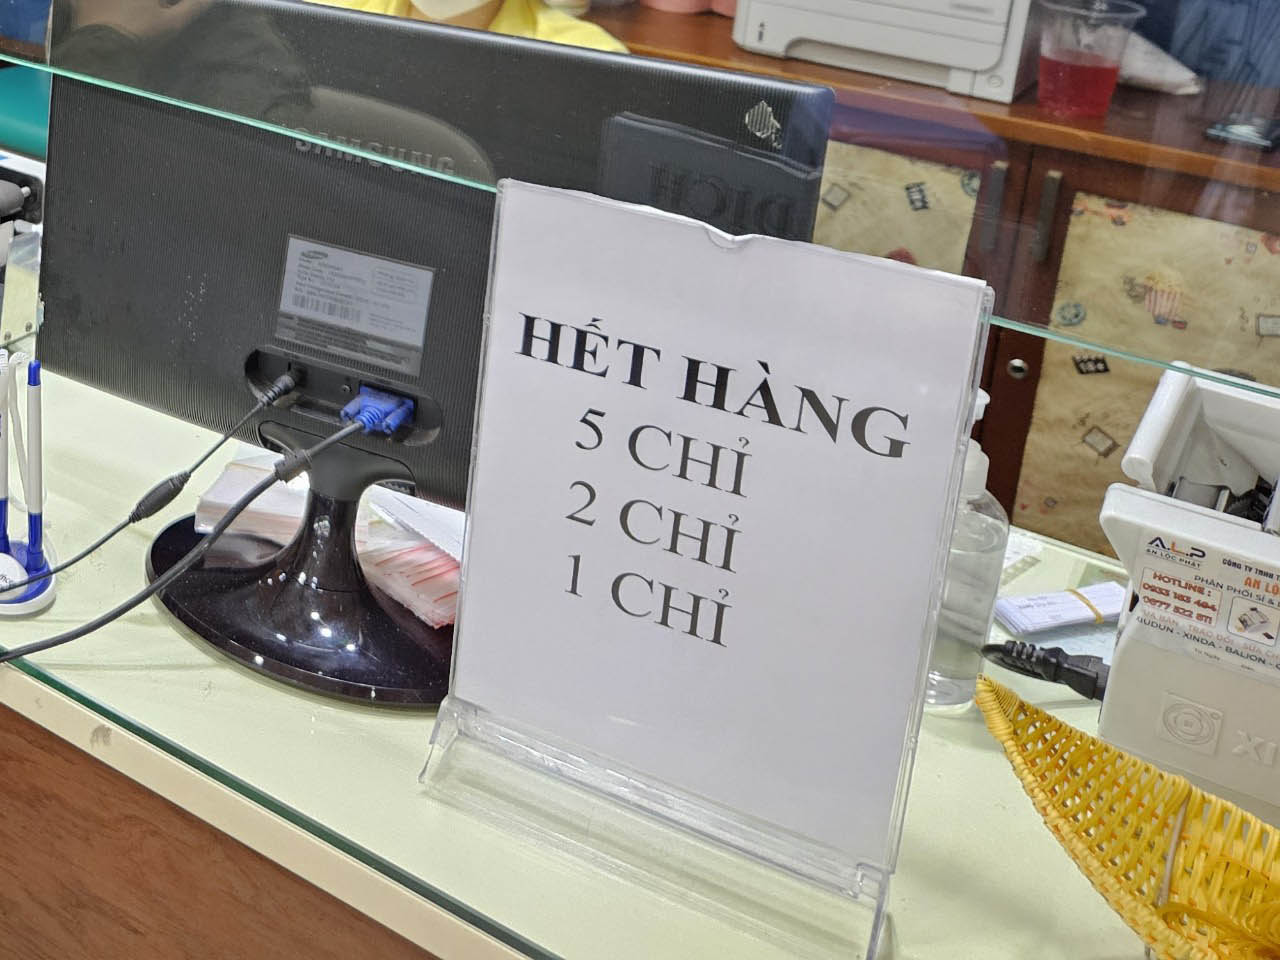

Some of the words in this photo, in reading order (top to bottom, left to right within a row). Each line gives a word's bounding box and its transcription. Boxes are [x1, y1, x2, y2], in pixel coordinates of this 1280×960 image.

[515, 311, 661, 391] HẾT
[675, 356, 912, 458] HÀNG
[574, 407, 604, 451] 5
[627, 422, 752, 498] CHỈ
[566, 480, 598, 526] 2
[618, 501, 744, 574] CHỈ
[564, 553, 583, 597] 1
[611, 572, 732, 648] CHỈ
[1153, 572, 1205, 595] HOTLINE
[1183, 631, 1217, 648] XINDA
